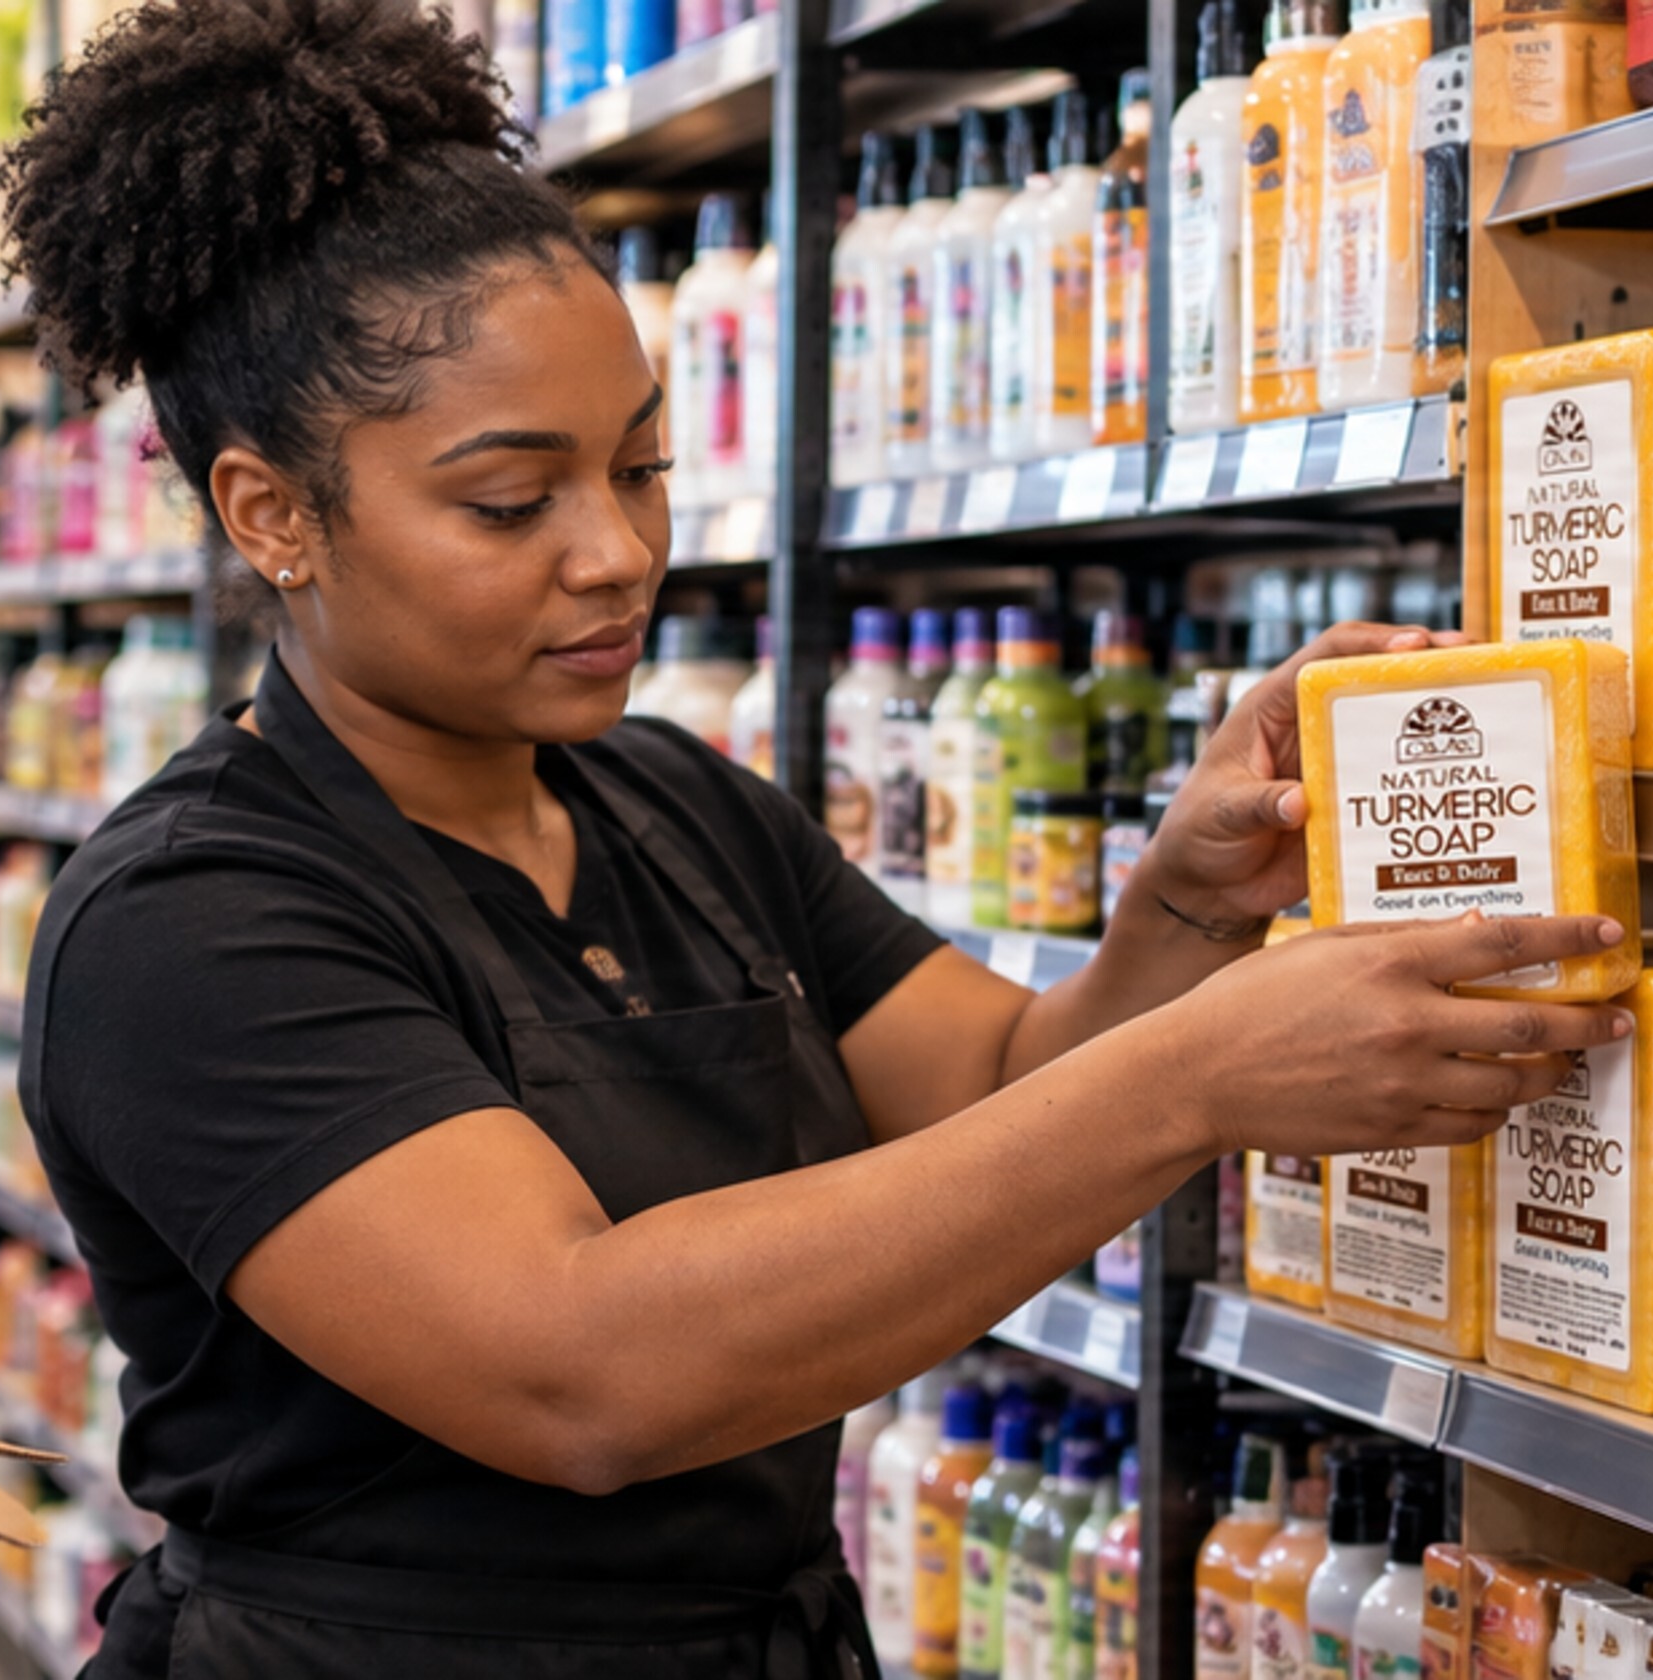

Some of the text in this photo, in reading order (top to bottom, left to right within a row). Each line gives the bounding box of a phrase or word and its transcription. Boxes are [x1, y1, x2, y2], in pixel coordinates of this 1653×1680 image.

[1509, 503, 1625, 546] TURMERIC
[1531, 546, 1599, 583] SOAP
[1381, 766, 1498, 791] NATURAL
[1348, 785, 1537, 827] TURMERIC
[1389, 823, 1495, 859] SOAP
[1507, 1124, 1623, 1176] TURMERIC
[1528, 1165, 1595, 1208] SOAP
